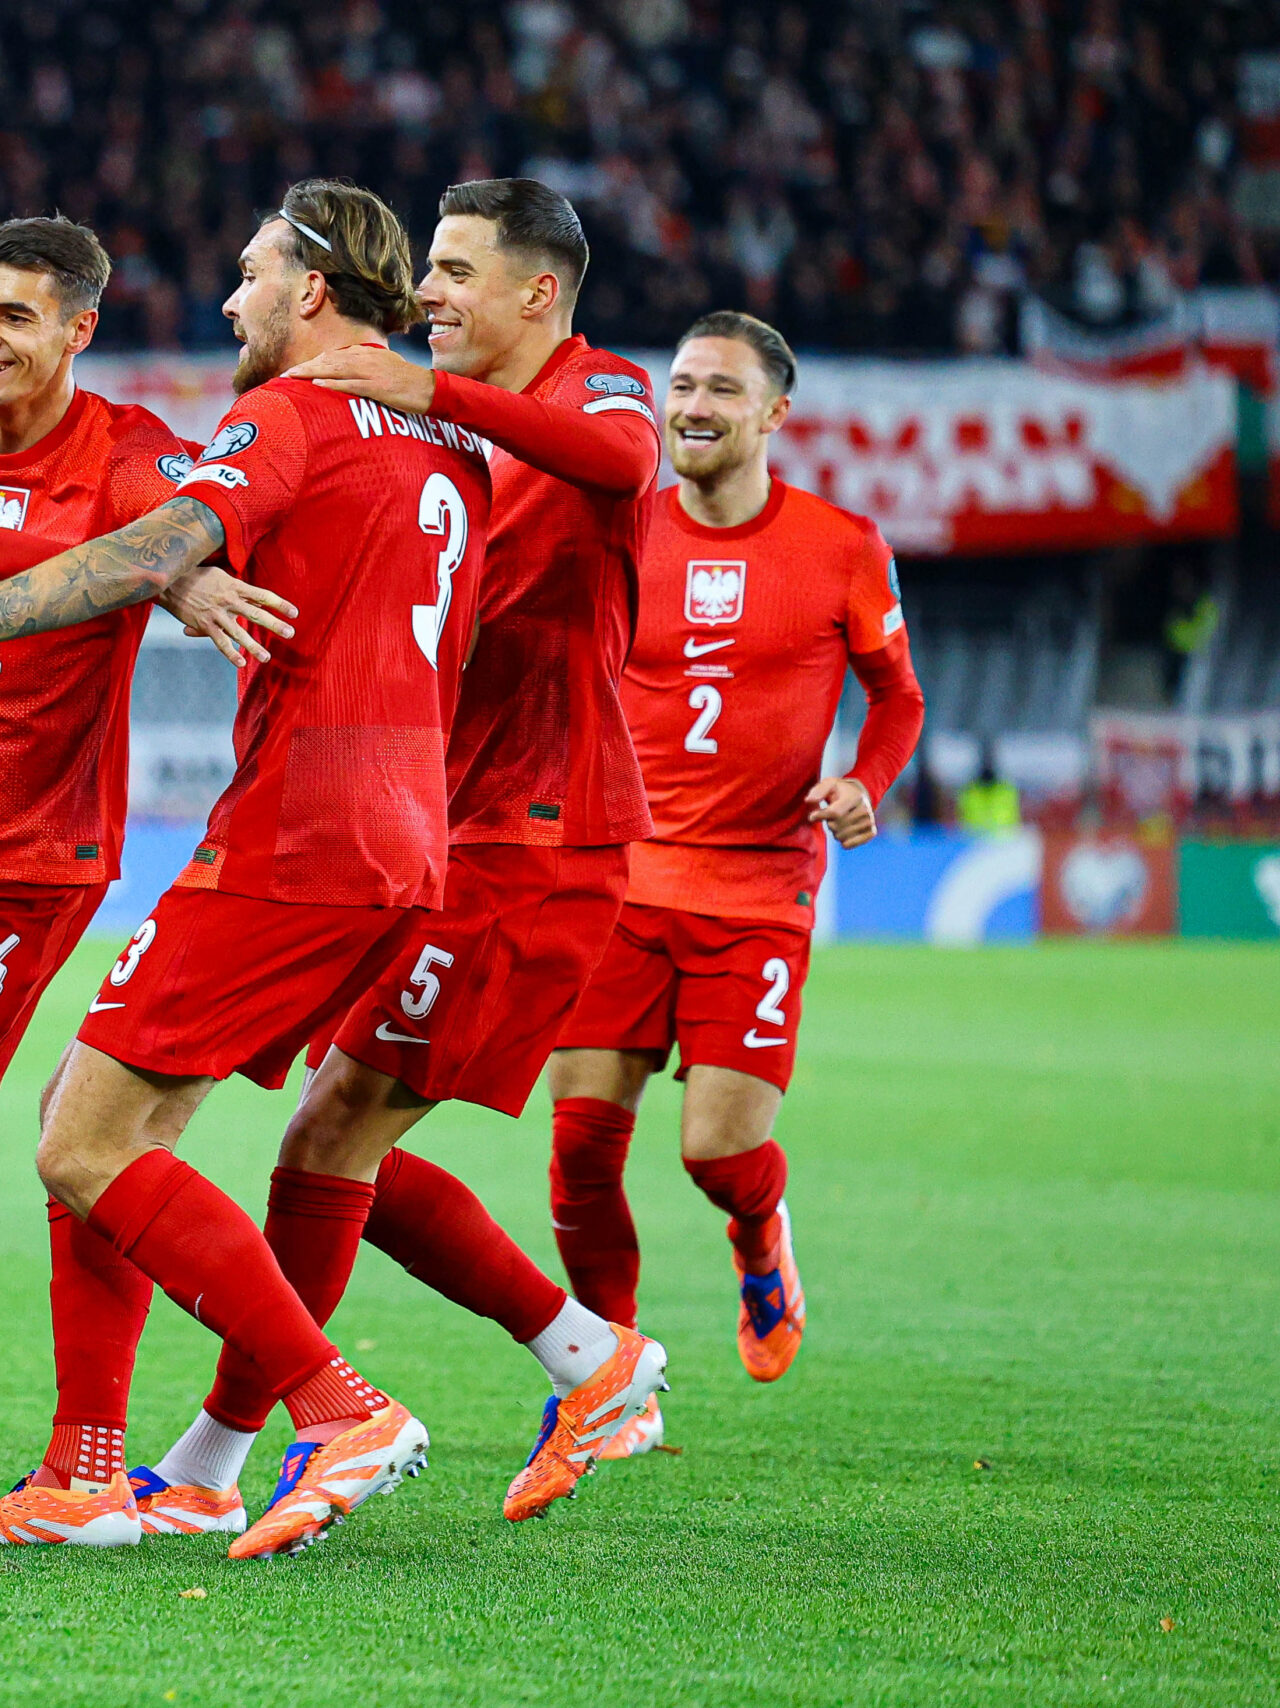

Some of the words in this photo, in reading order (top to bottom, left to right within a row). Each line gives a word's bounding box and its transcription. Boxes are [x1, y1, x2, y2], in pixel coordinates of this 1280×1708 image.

[411, 472, 469, 672] 3
[684, 684, 723, 754] 2
[109, 918, 158, 987] 3
[400, 943, 455, 1020] 5
[755, 957, 790, 1027] 2
